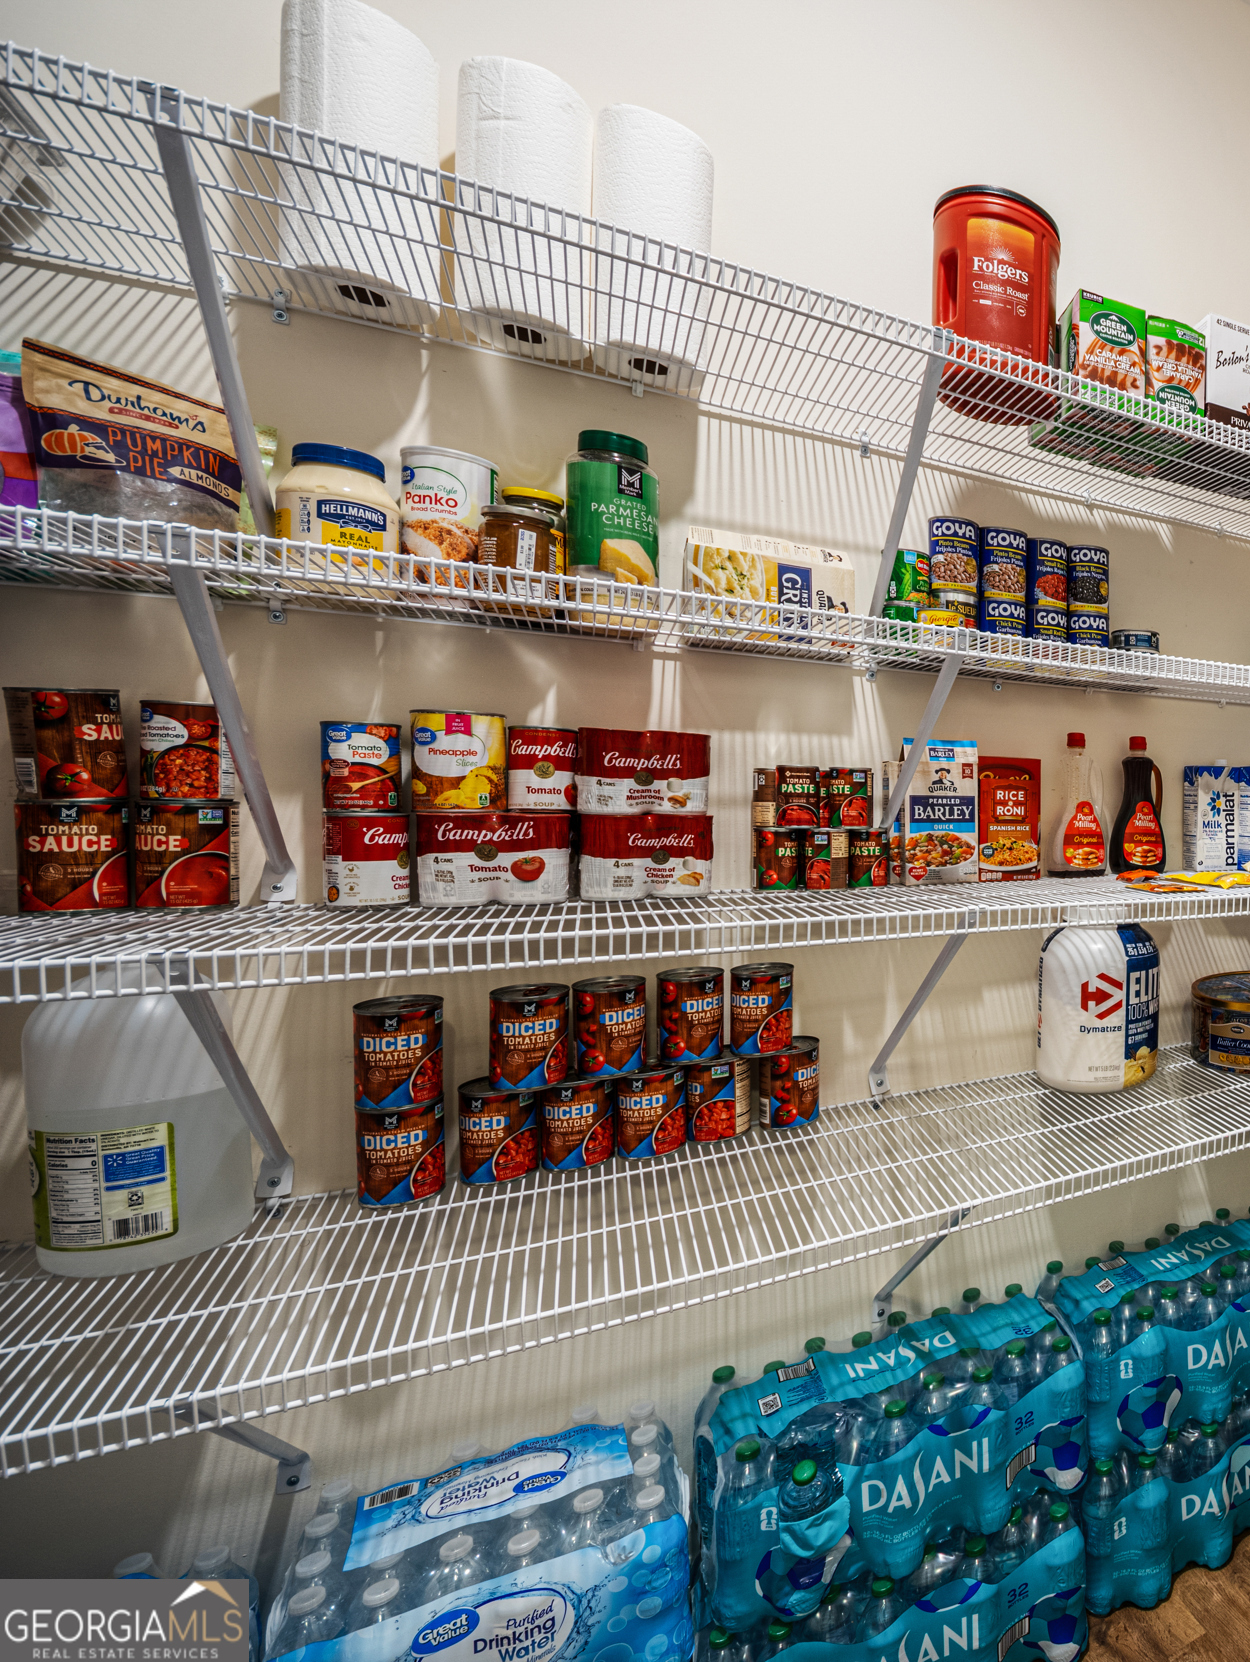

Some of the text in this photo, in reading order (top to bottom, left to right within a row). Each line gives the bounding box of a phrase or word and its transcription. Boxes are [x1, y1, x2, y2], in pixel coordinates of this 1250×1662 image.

[972, 256, 1029, 283] Folgers
[972, 280, 1030, 301] Classic Roast
[1083, 292, 1103, 302] KEURIG
[1094, 324, 1134, 341] MOUNTAIN
[1100, 318, 1127, 332] GREEN
[1223, 320, 1236, 330] SINGLE
[1237, 324, 1250, 334] SERVE
[1085, 354, 1141, 375] VANILLA CREAM
[1097, 350, 1131, 365] CARAMEL
[1215, 345, 1250, 370] Boston's
[68, 379, 207, 434] Durham's
[107, 427, 221, 477] PUMPKIN
[128, 452, 230, 498] PIE ALMONDS
[405, 492, 458, 508] Panko
[613, 498, 647, 510] GRATED
[321, 503, 384, 526] HELLMANN'S
[410, 505, 458, 516] Bread Crumbs
[602, 514, 654, 534] CHEESE
[932, 522, 976, 540] GOYA
[339, 531, 371, 544] REAL
[987, 531, 1026, 550] GOYA
[1071, 549, 1108, 565] GOYA
[988, 602, 1026, 620] GOYA
[928, 615, 958, 625] Giorgio
[1071, 616, 1107, 631] GOYA
[352, 751, 382, 759] Paste
[428, 748, 477, 757] Pineapple
[456, 759, 478, 767] Slices
[603, 752, 682, 770] Campbell's
[526, 786, 562, 795] Tomato
[781, 784, 815, 794] PASTE
[928, 785, 958, 793] QUAKER
[996, 790, 1025, 801] RICE
[914, 805, 973, 821] BARLEY
[996, 805, 1025, 816] RONI
[1077, 813, 1094, 821] Pearl
[40, 825, 98, 834] TOMATO
[435, 821, 534, 844] Campbell's
[1202, 820, 1222, 829] Milk
[1222, 792, 1237, 867] parmalat
[28, 836, 112, 852] SAUCE
[628, 832, 695, 849] Campbell's
[1074, 836, 1098, 844] Original
[1134, 834, 1156, 843] Original
[850, 847, 880, 856] PASTE
[468, 864, 508, 873] Tomato
[605, 1003, 646, 1025] DICED
[503, 1019, 556, 1037] DICED
[1080, 1025, 1122, 1034] Dymatize
[364, 1035, 424, 1052] DICED
[503, 1034, 556, 1045] TOMATOES
[1217, 1037, 1235, 1047] Butter
[364, 1050, 422, 1061] TOMATOES
[619, 1095, 664, 1109] DICED
[546, 1103, 594, 1119] DICED
[620, 1108, 663, 1117] TOMATOES
[546, 1117, 593, 1128] TOMATOES
[364, 1130, 424, 1149] DICED
[365, 1146, 422, 1159] TOMATOES
[1150, 1237, 1231, 1272] DASANI
[844, 1330, 957, 1379] DASANI
[1014, 1410, 1034, 1429] 32
[860, 1437, 991, 1516] DASANI
[506, 1599, 555, 1630] Purified
[418, 1613, 469, 1644] Great
[430, 1625, 469, 1646] Value
[474, 1615, 556, 1654] Drinking
[498, 1630, 557, 1662] Water
